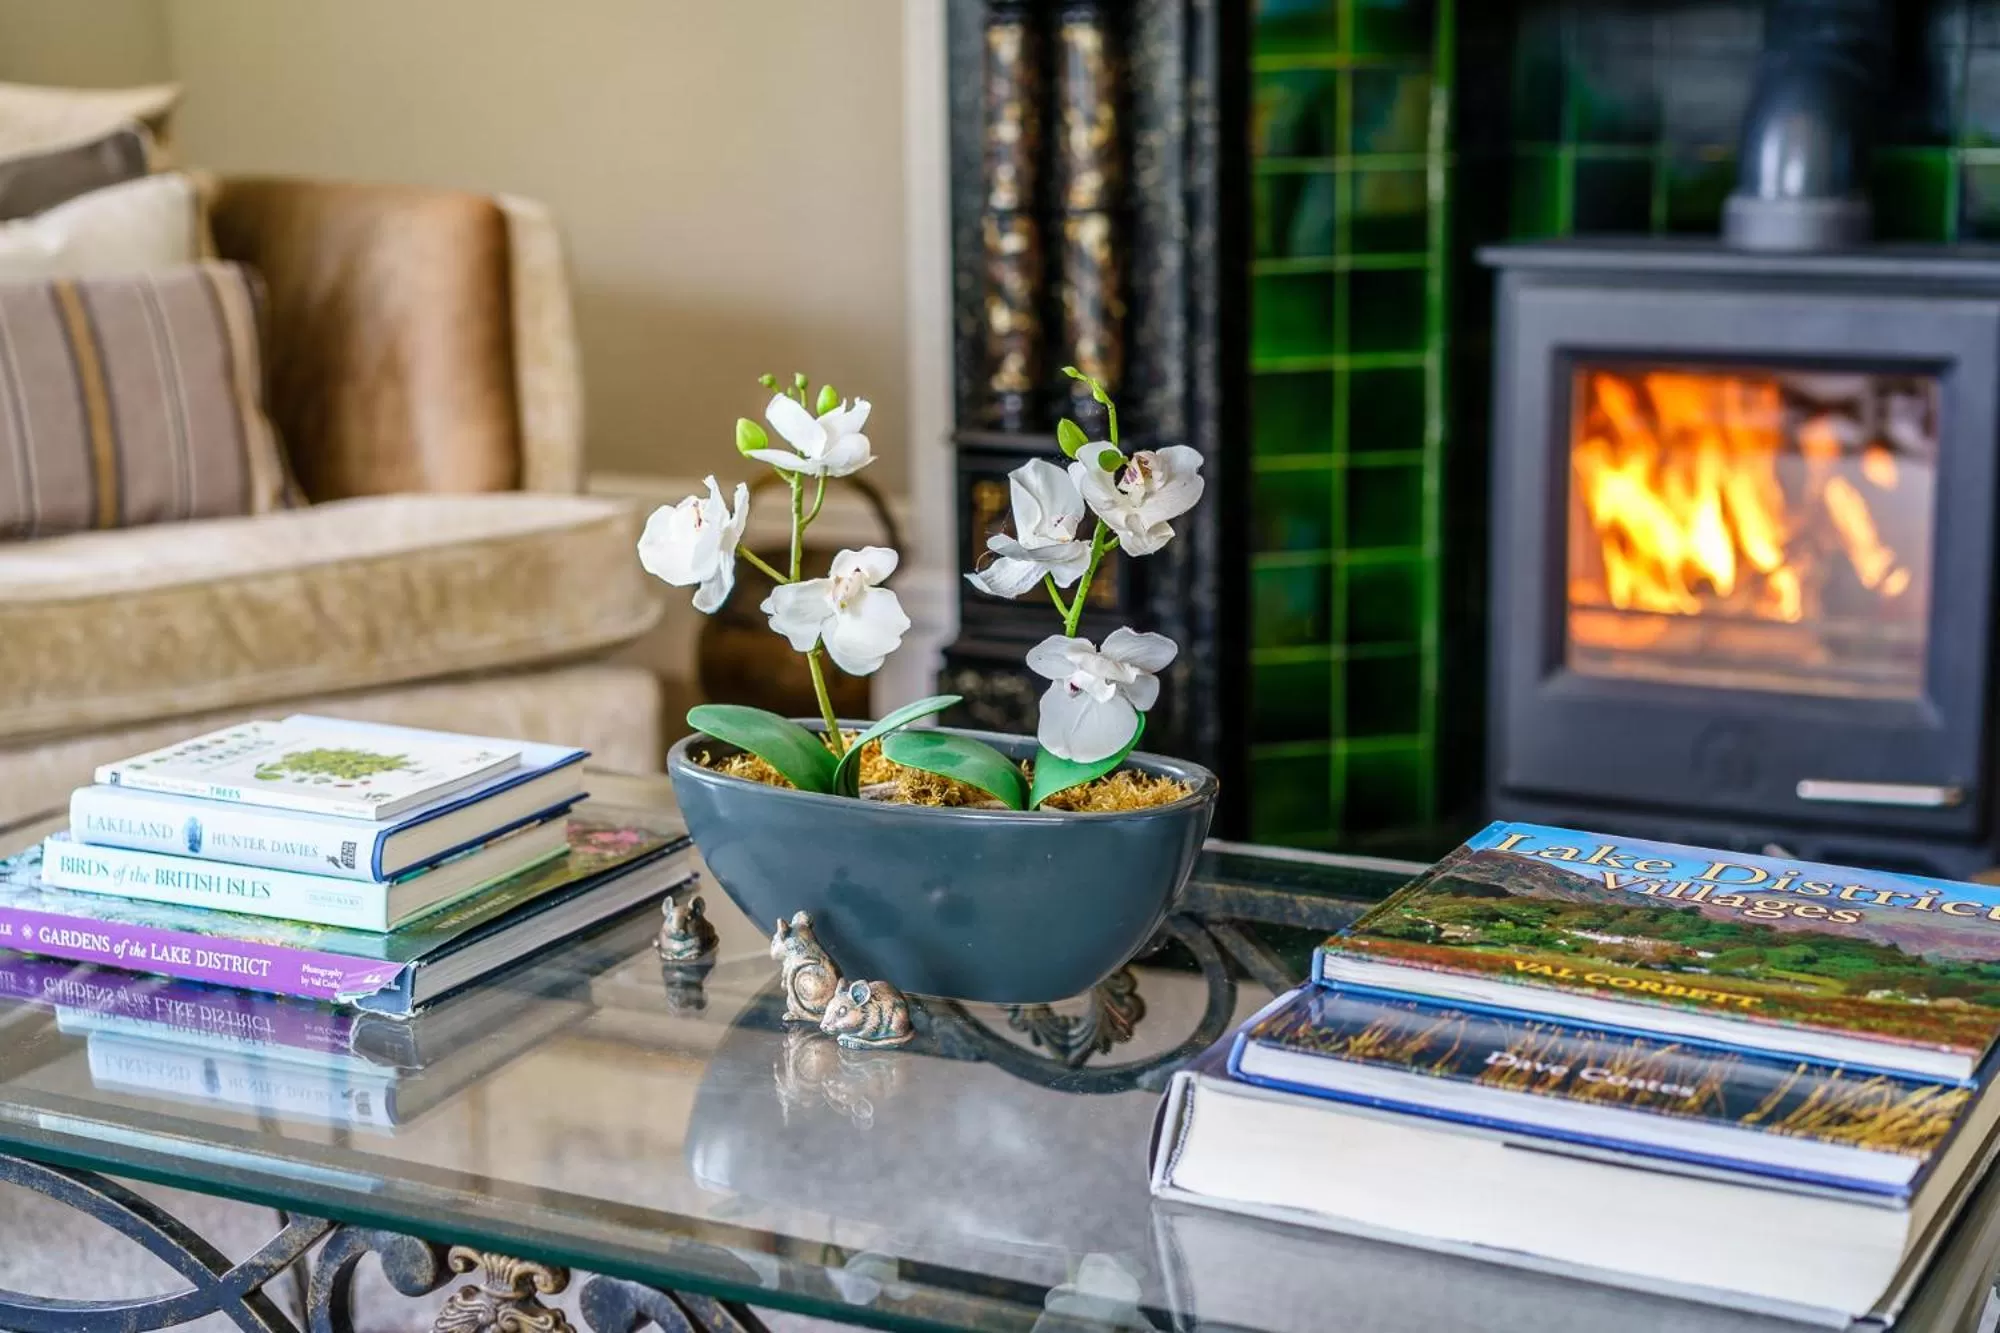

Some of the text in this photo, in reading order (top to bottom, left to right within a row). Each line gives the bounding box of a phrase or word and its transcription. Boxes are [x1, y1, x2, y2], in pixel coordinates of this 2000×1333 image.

[86, 813, 174, 839] LAKELAND
[212, 831, 265, 851] HUNTER
[271, 839, 318, 857] DAVIES
[1488, 832, 1676, 874] Lake
[60, 855, 271, 898] BIRDS of the BRITISH ISLES
[1601, 871, 1865, 925] Villages
[39, 926, 110, 952] GARDENS
[113, 938, 130, 959] of
[129, 941, 147, 958] the
[151, 943, 191, 965] LAKE
[195, 949, 271, 977] DISTRICT
[1513, 960, 1763, 1008] VAL CORBETT
